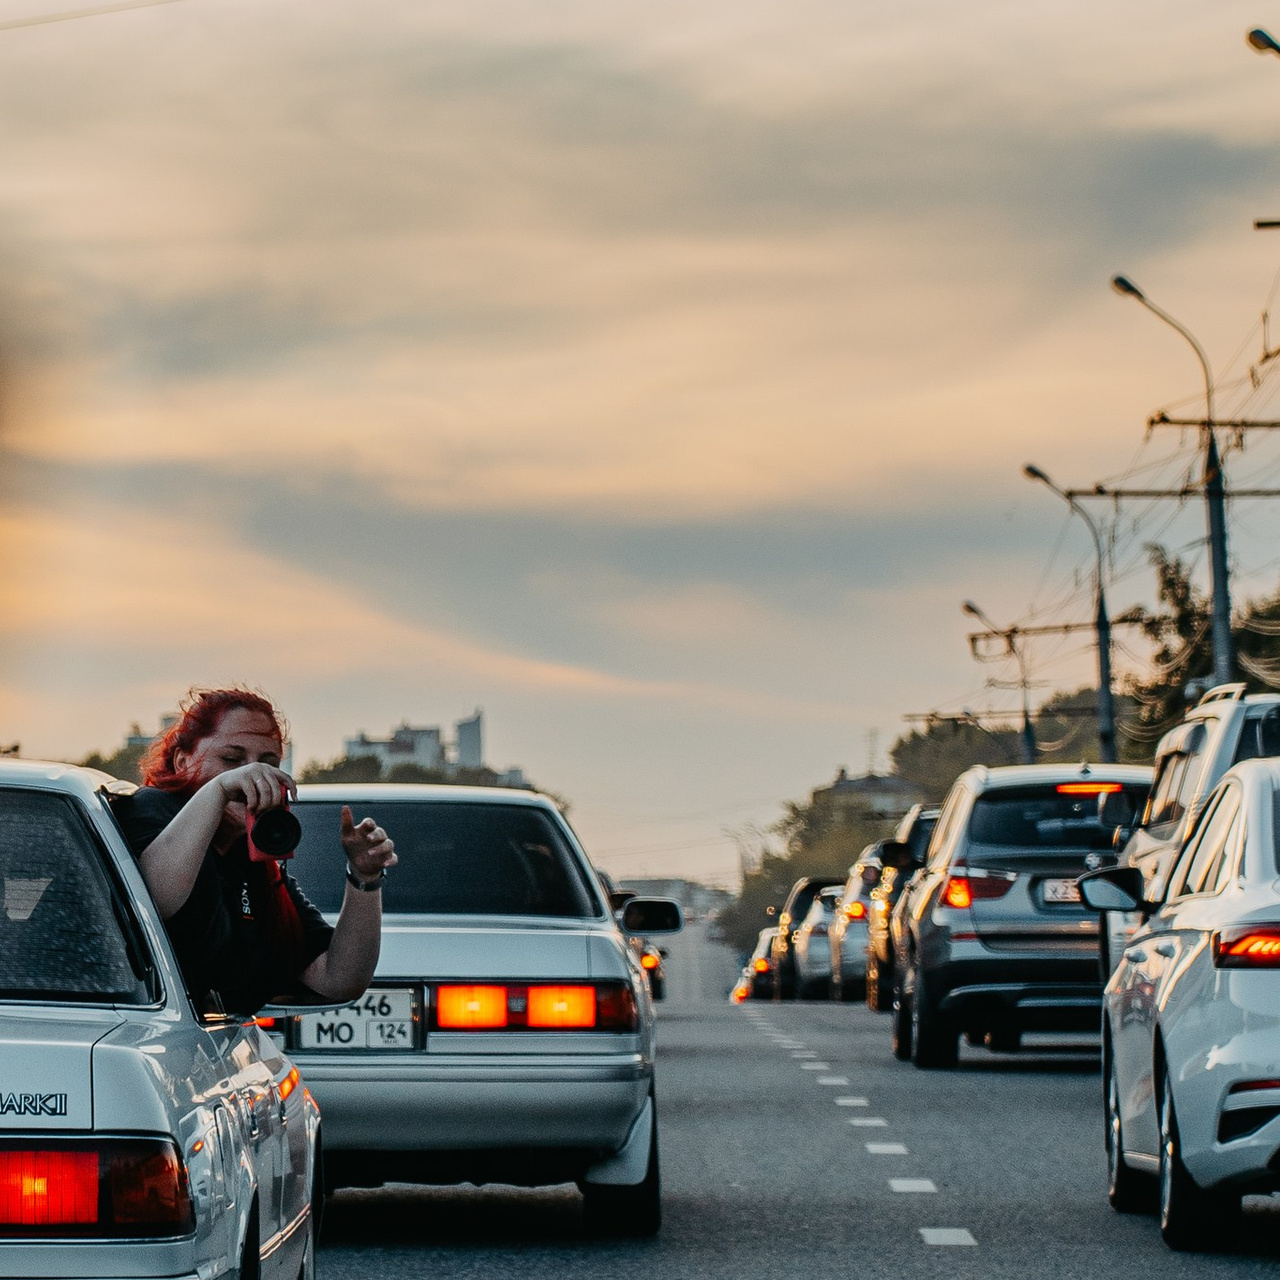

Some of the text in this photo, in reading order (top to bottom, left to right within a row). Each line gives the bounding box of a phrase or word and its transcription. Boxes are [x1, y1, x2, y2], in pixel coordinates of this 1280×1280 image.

[241, 882, 251, 915] SON
[316, 1022, 407, 1043] MO 124
